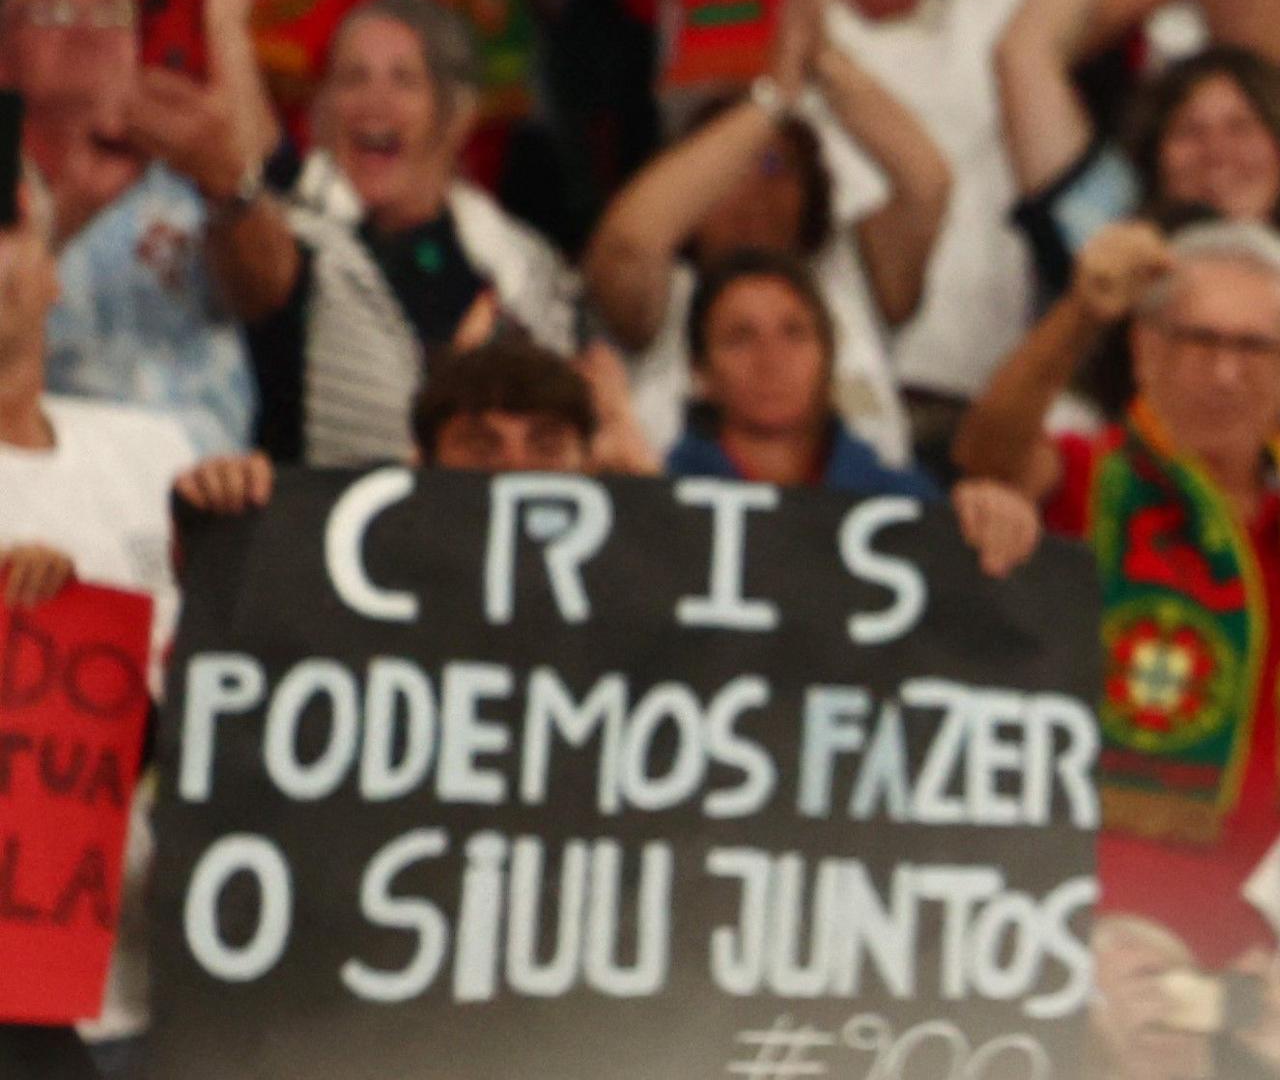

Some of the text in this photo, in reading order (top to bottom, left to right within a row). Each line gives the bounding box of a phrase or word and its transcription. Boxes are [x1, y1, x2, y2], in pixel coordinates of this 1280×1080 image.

[323, 466, 927, 644] CRIS
[178, 652, 1099, 830] PODEMOS FAZER
[184, 833, 292, 983] O
[705, 846, 1099, 1019] JUNTOS
